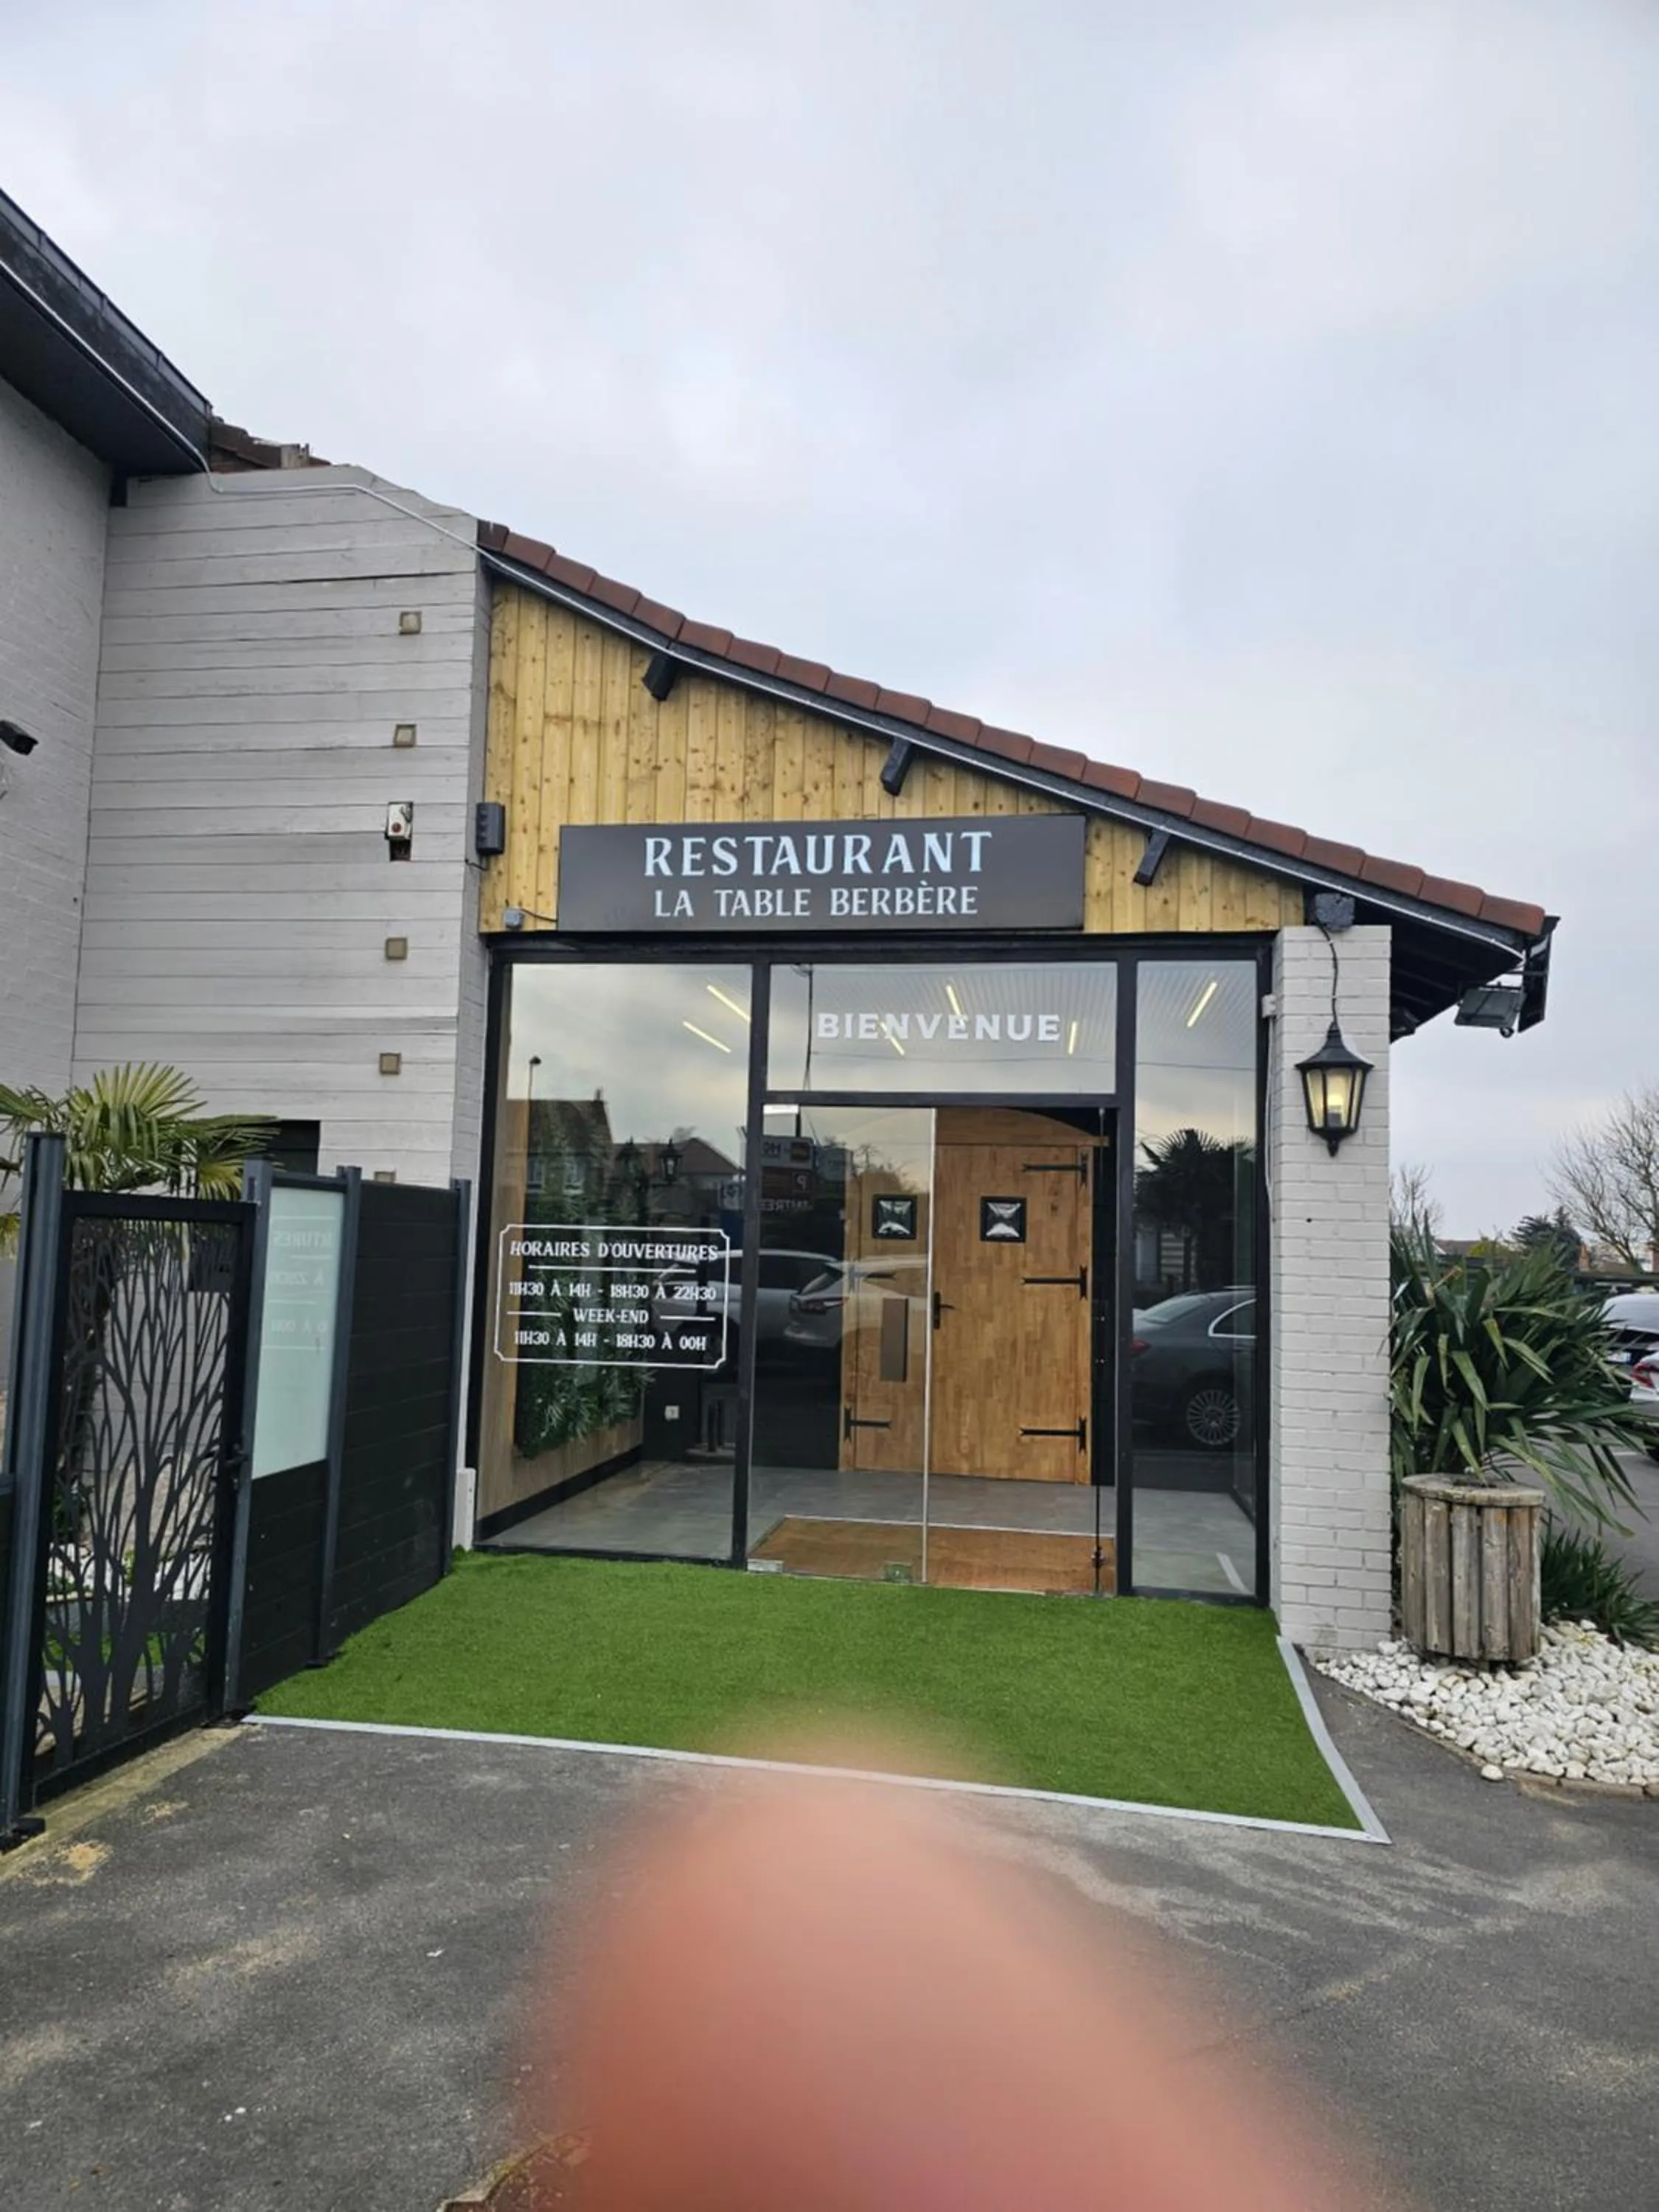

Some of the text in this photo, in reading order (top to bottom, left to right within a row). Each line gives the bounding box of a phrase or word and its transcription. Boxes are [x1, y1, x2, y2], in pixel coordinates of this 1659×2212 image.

[644, 831, 992, 877] RESTAURANT
[653, 881, 978, 917] LA TABLE BERBÈRE
[817, 1012, 1062, 1041] BIENVENUE
[510, 1240, 719, 1260] HORAIRES D'OUVERTURES
[509, 1281, 544, 1296] 11H30
[550, 1280, 562, 1297] À
[568, 1283, 591, 1298] 14H
[610, 1284, 649, 1299] 18H30
[655, 1282, 666, 1300] À
[673, 1285, 716, 1301] 22H30
[573, 1308, 649, 1324] WEEK-END
[515, 1330, 549, 1346] 11H30
[556, 1329, 567, 1346] À
[574, 1332, 597, 1348] 14H
[616, 1333, 655, 1349] 18H30
[661, 1331, 672, 1350] À
[679, 1335, 707, 1351] 00H
